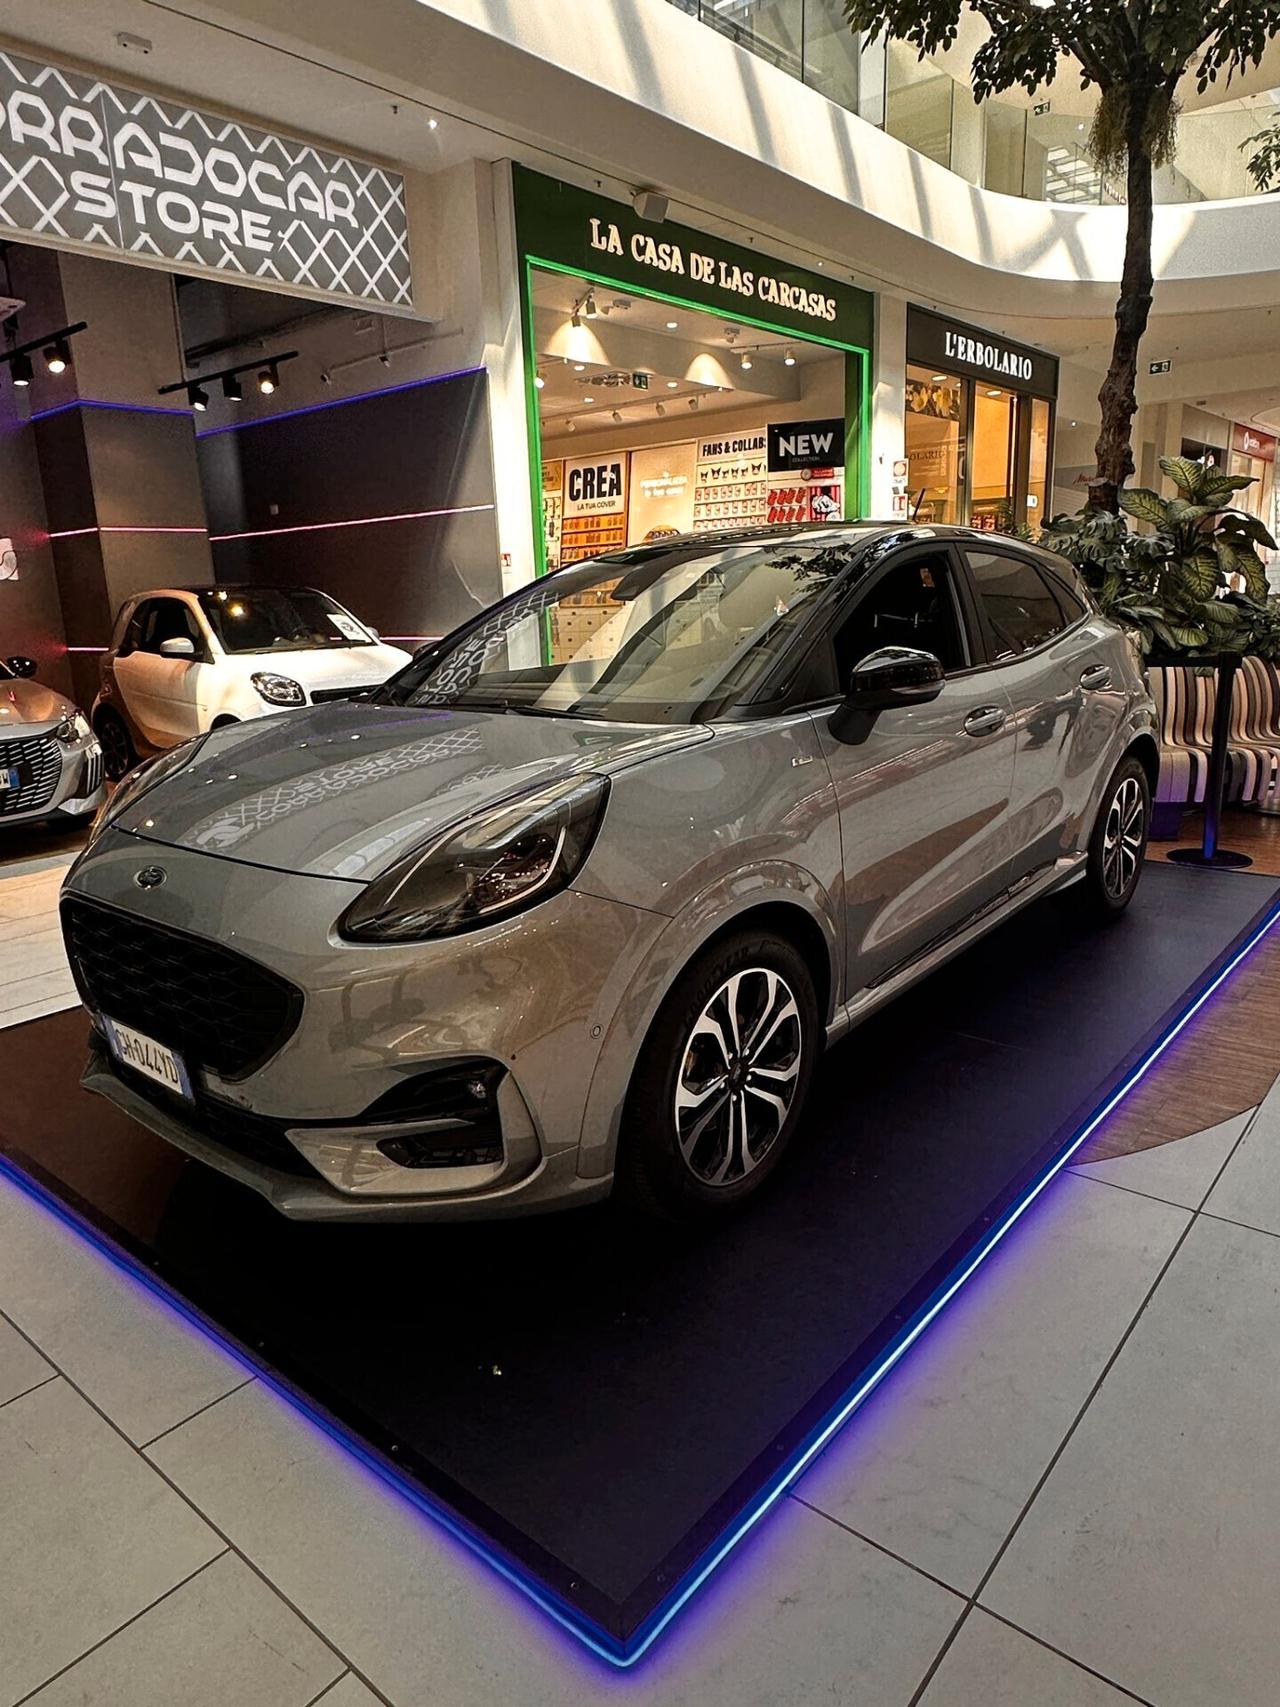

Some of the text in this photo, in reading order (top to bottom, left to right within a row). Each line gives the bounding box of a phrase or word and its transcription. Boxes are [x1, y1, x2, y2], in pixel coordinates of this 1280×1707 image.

[0, 90, 359, 228] RRADOCAR
[70, 170, 274, 252] STORE
[589, 217, 837, 321] LA CASA DE LAS CARCASAS
[945, 331, 1032, 380] L'ERBOLARIO
[724, 441, 731, 453] &
[779, 432, 834, 457] NEW
[569, 463, 622, 502] CREA
[577, 499, 616, 511] LA TUA COVER
